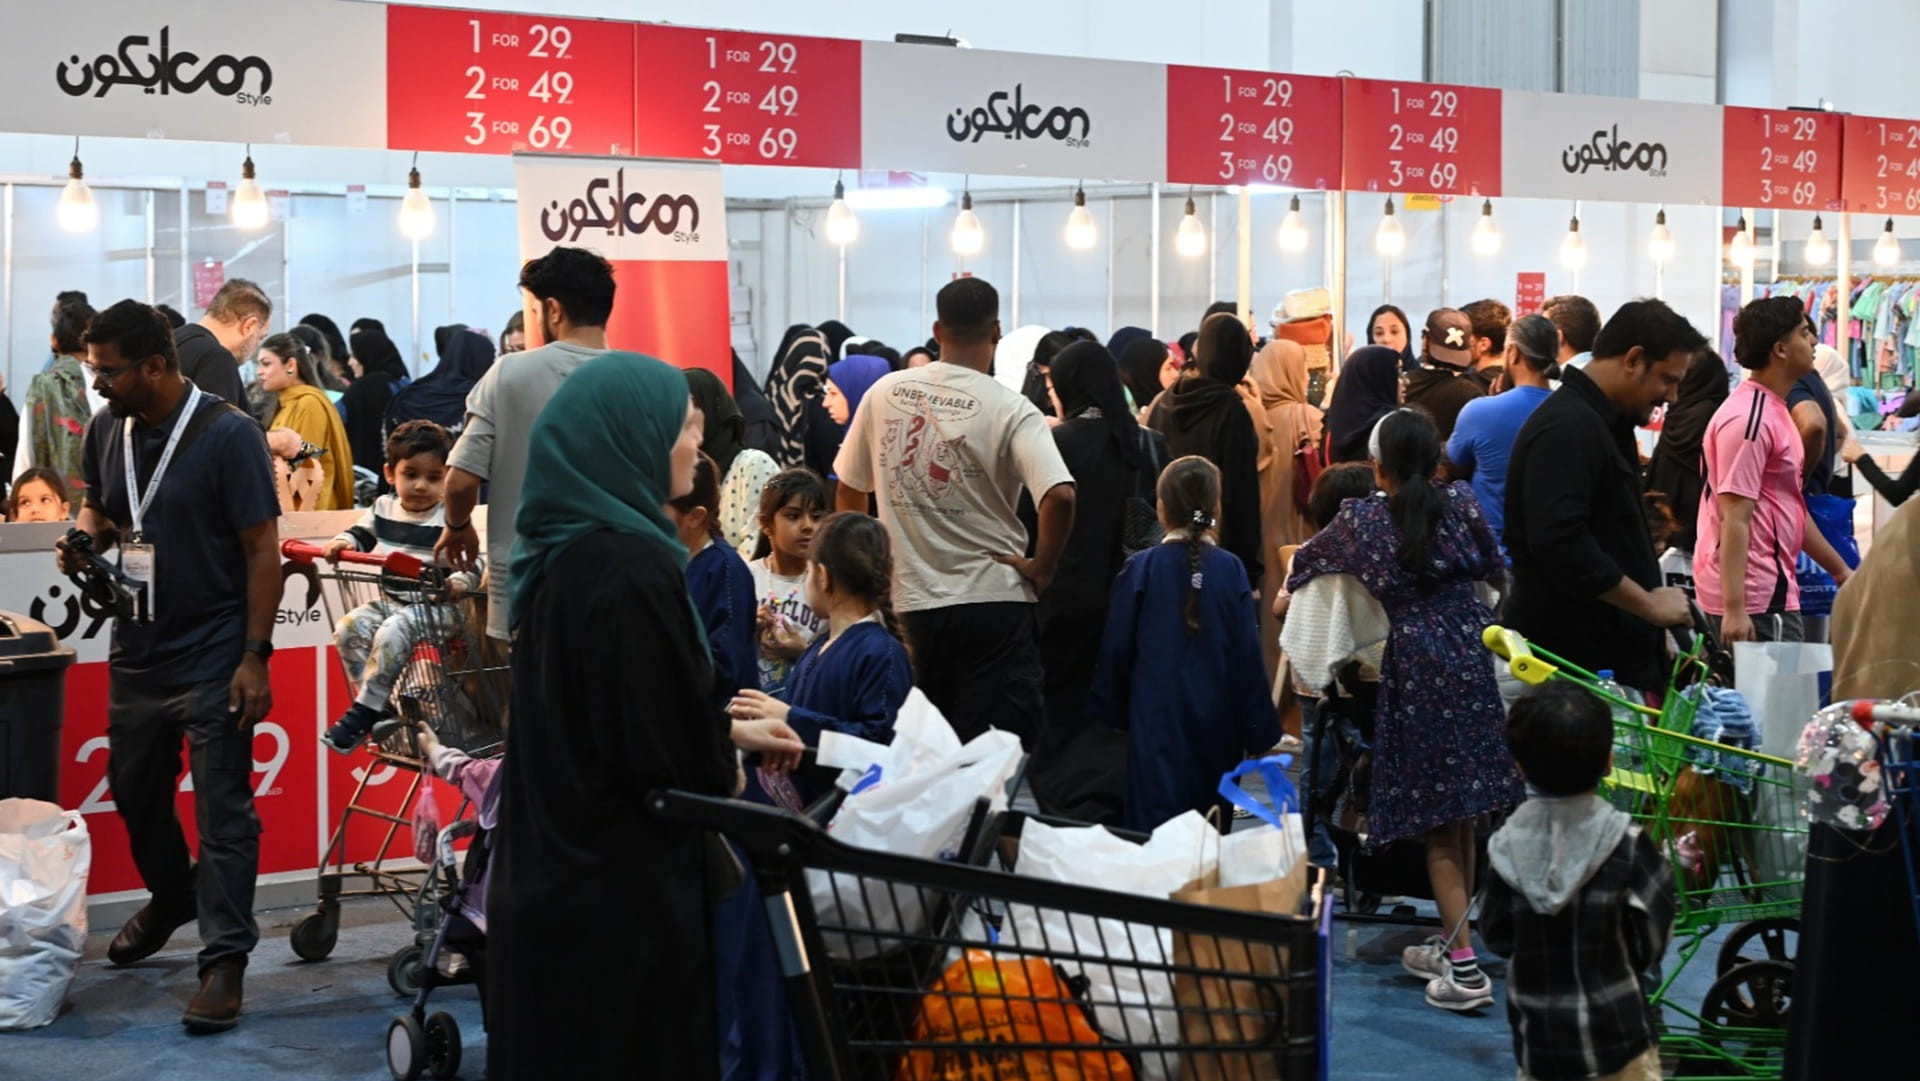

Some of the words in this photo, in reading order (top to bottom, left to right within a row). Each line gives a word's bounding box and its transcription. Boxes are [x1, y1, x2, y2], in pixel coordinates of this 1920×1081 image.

[469, 20, 480, 53] 1
[492, 33, 519, 47] FOR
[528, 24, 572, 59] 29
[705, 37, 716, 69] 1
[726, 50, 750, 63] FOR
[758, 41, 797, 73] 29
[236, 92, 272, 107] Style
[464, 66, 486, 100] 2
[492, 77, 519, 91] FOR
[528, 71, 573, 104] 49
[702, 80, 721, 113] 2
[726, 91, 750, 104] FOR
[758, 85, 798, 116] 49
[1223, 75, 1231, 103] 1
[1238, 87, 1257, 98] FOR
[1263, 79, 1292, 107] 29
[1392, 88, 1400, 115] 1
[1406, 98, 1424, 109] FOR
[1429, 90, 1457, 117] 29
[464, 112, 486, 146] 3
[492, 121, 519, 134] FOR
[528, 116, 572, 149] 69
[702, 125, 721, 156] 3
[726, 133, 750, 145] FOR
[758, 128, 797, 159] 69
[1219, 113, 1234, 141] 2
[1238, 123, 1257, 134] FOR
[1262, 117, 1293, 144] 49
[1389, 124, 1403, 151] 2
[1406, 133, 1424, 143] FOR
[1429, 127, 1458, 153] 49
[1763, 114, 1770, 138] 1
[1775, 124, 1789, 133] FOR
[1793, 117, 1816, 141] 29
[1879, 123, 1886, 146] 1
[1907, 126, 1920, 148] 2
[1066, 136, 1090, 149] Style
[1219, 152, 1235, 179] 3
[1238, 159, 1257, 169] FOR
[1263, 154, 1292, 182] 69
[1388, 160, 1403, 187] 3
[1406, 168, 1424, 177] FOR
[1429, 163, 1457, 189] 69
[1760, 147, 1772, 171] 2
[1774, 154, 1789, 164] FOR
[1792, 149, 1817, 173] 49
[1876, 155, 1887, 178] 2
[1906, 157, 1920, 179] 4
[1760, 179, 1772, 203] 3
[1774, 186, 1789, 195] FOR
[1792, 182, 1816, 205] 69
[1876, 186, 1887, 209] 3
[1906, 188, 1920, 210] 6
[673, 231, 700, 243] Style
[274, 609, 321, 627] Style
